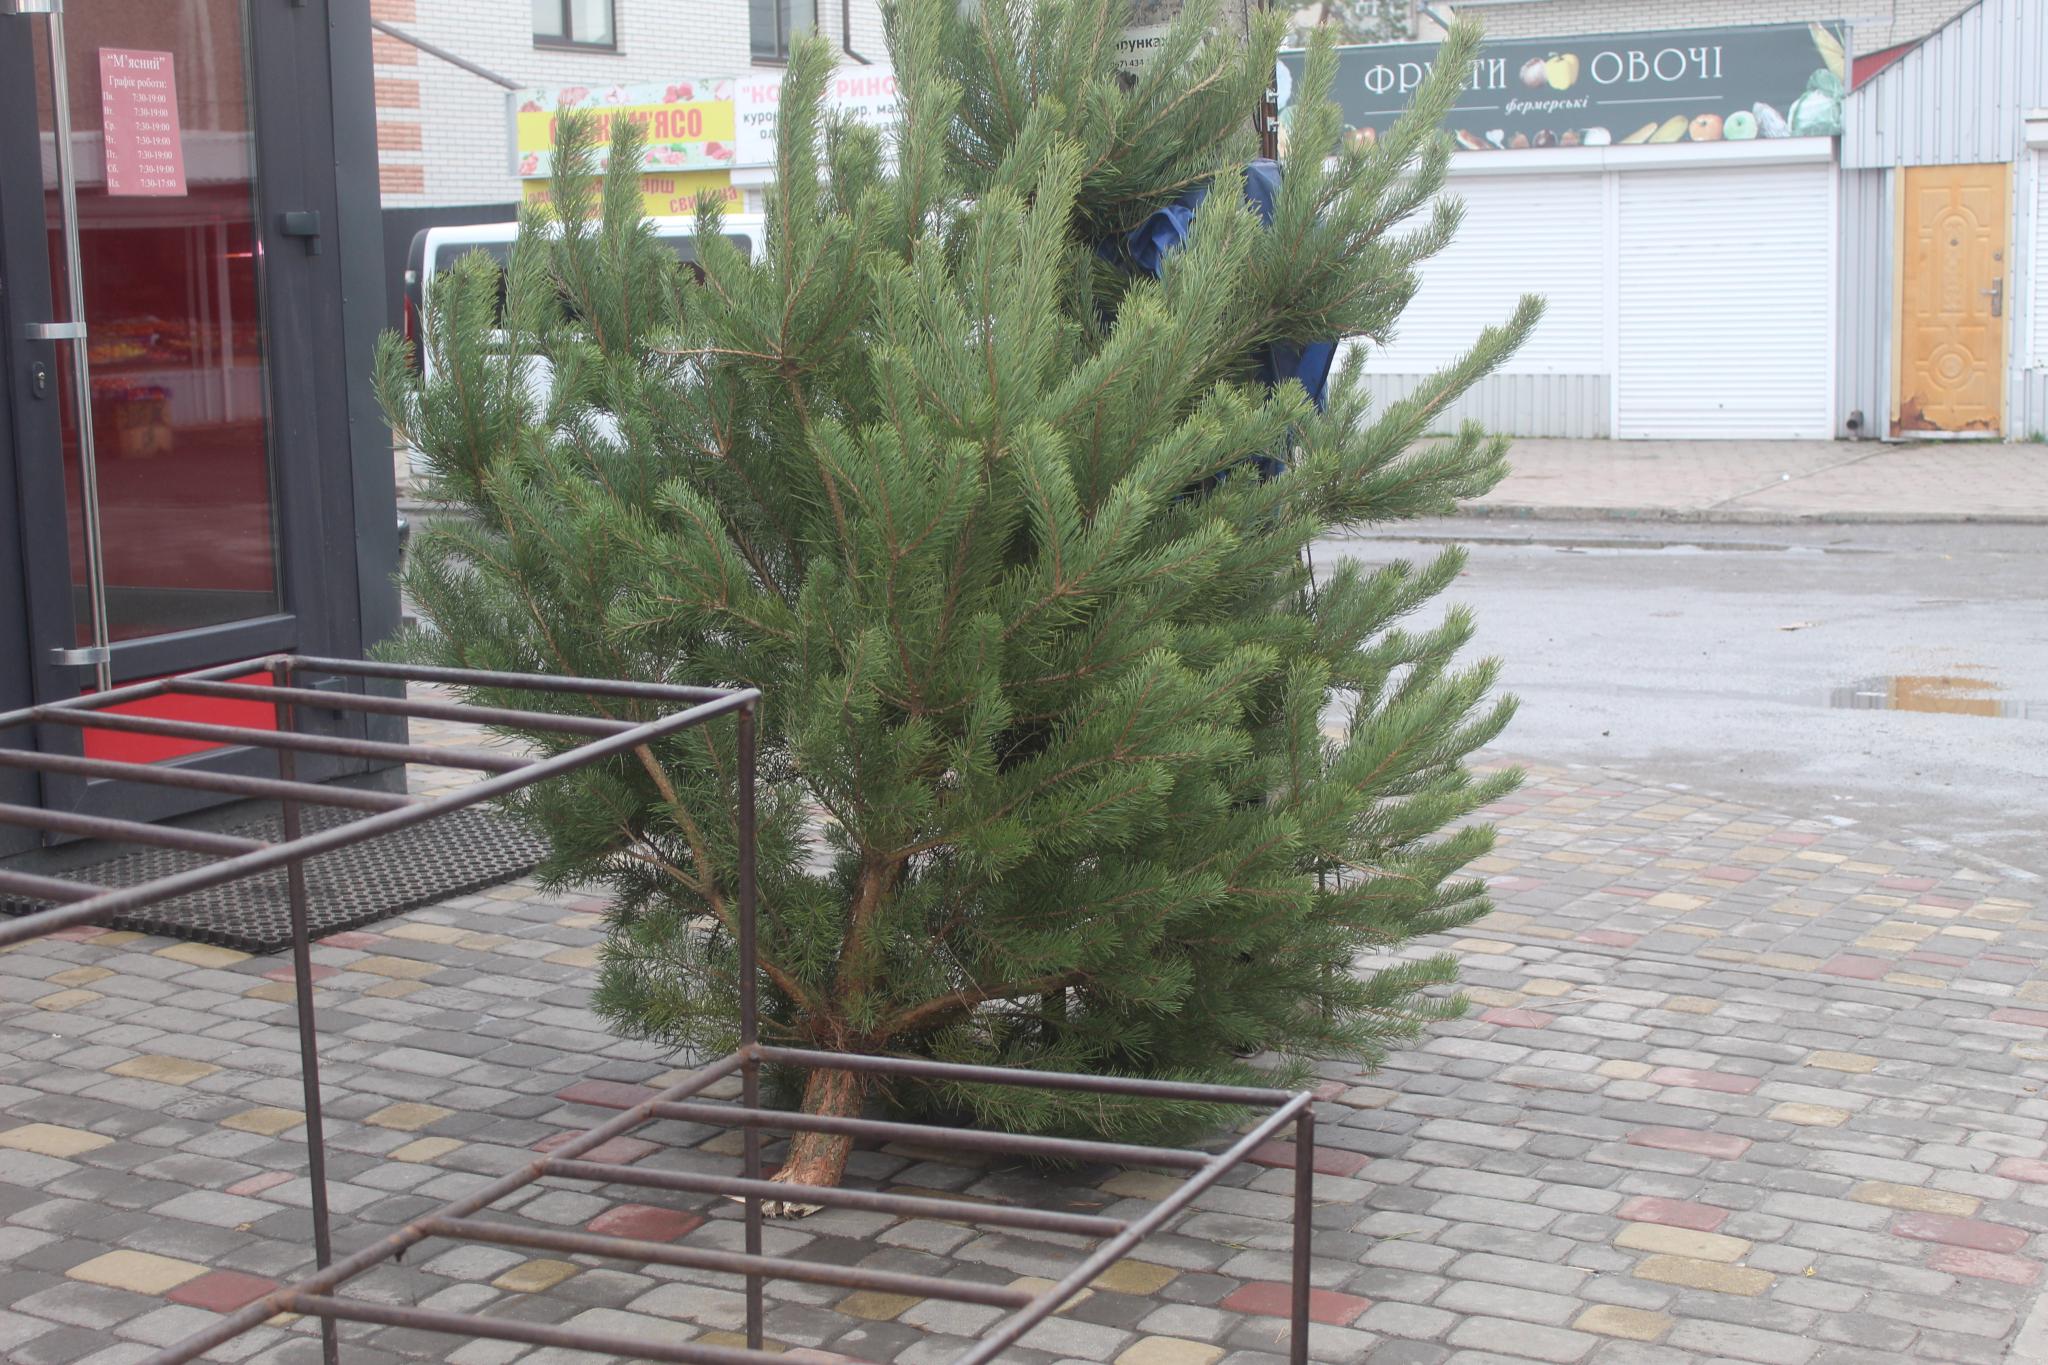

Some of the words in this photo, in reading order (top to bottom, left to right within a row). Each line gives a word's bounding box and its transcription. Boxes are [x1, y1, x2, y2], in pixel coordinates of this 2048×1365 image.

[1365, 58, 1507, 94] ФРТИ
[1591, 46, 1724, 84] ОВОЧІ
[109, 75, 136, 89] Графік
[137, 77, 167, 90] роботи:
[132, 93, 167, 103] 7:30-19:00
[1504, 95, 1590, 115] фермерські
[133, 107, 168, 117] 7:30-19:00
[135, 121, 170, 131] 7:30-19:00
[136, 136, 171, 145] 7:30-19:00
[137, 150, 173, 160] 7:30-19:00
[139, 164, 175, 174] 7:30-19:00
[140, 179, 176, 188] 7:30-17:00
